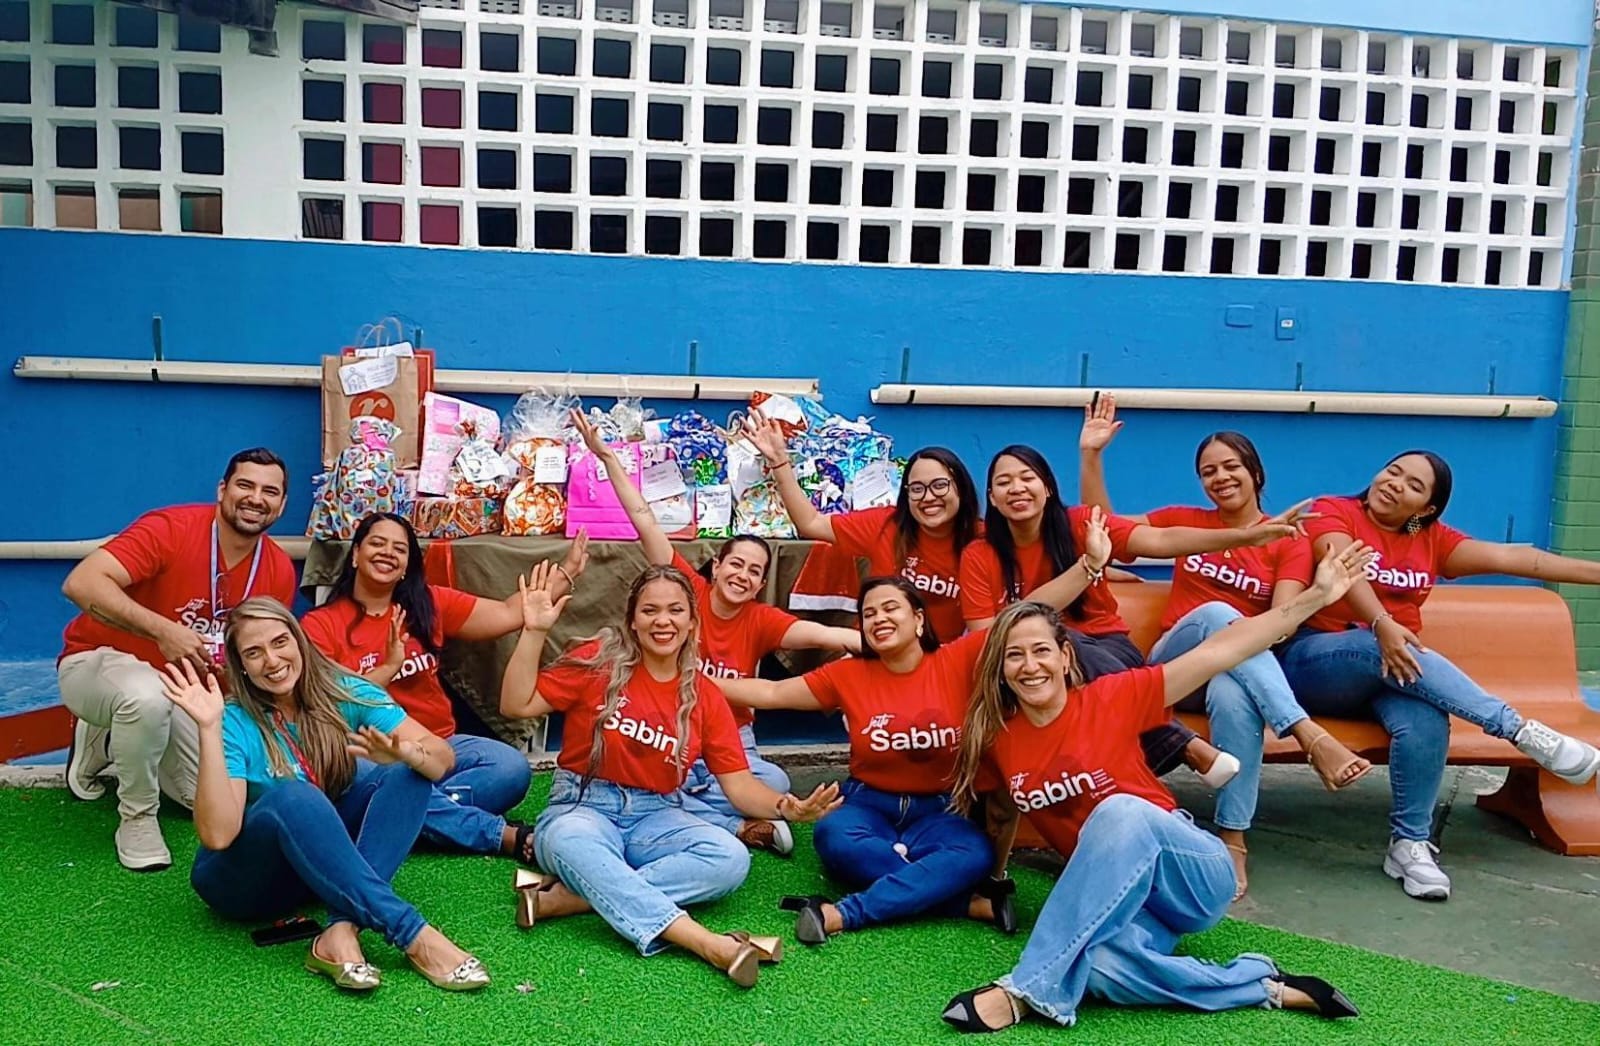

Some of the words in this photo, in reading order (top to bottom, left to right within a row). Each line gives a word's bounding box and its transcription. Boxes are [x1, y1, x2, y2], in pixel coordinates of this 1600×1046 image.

[1183, 553, 1261, 595] Sabin
[1363, 560, 1431, 589] Sabin
[603, 709, 680, 757] Sabin
[870, 722, 956, 752] Sabin
[1012, 771, 1097, 813] Sabin
